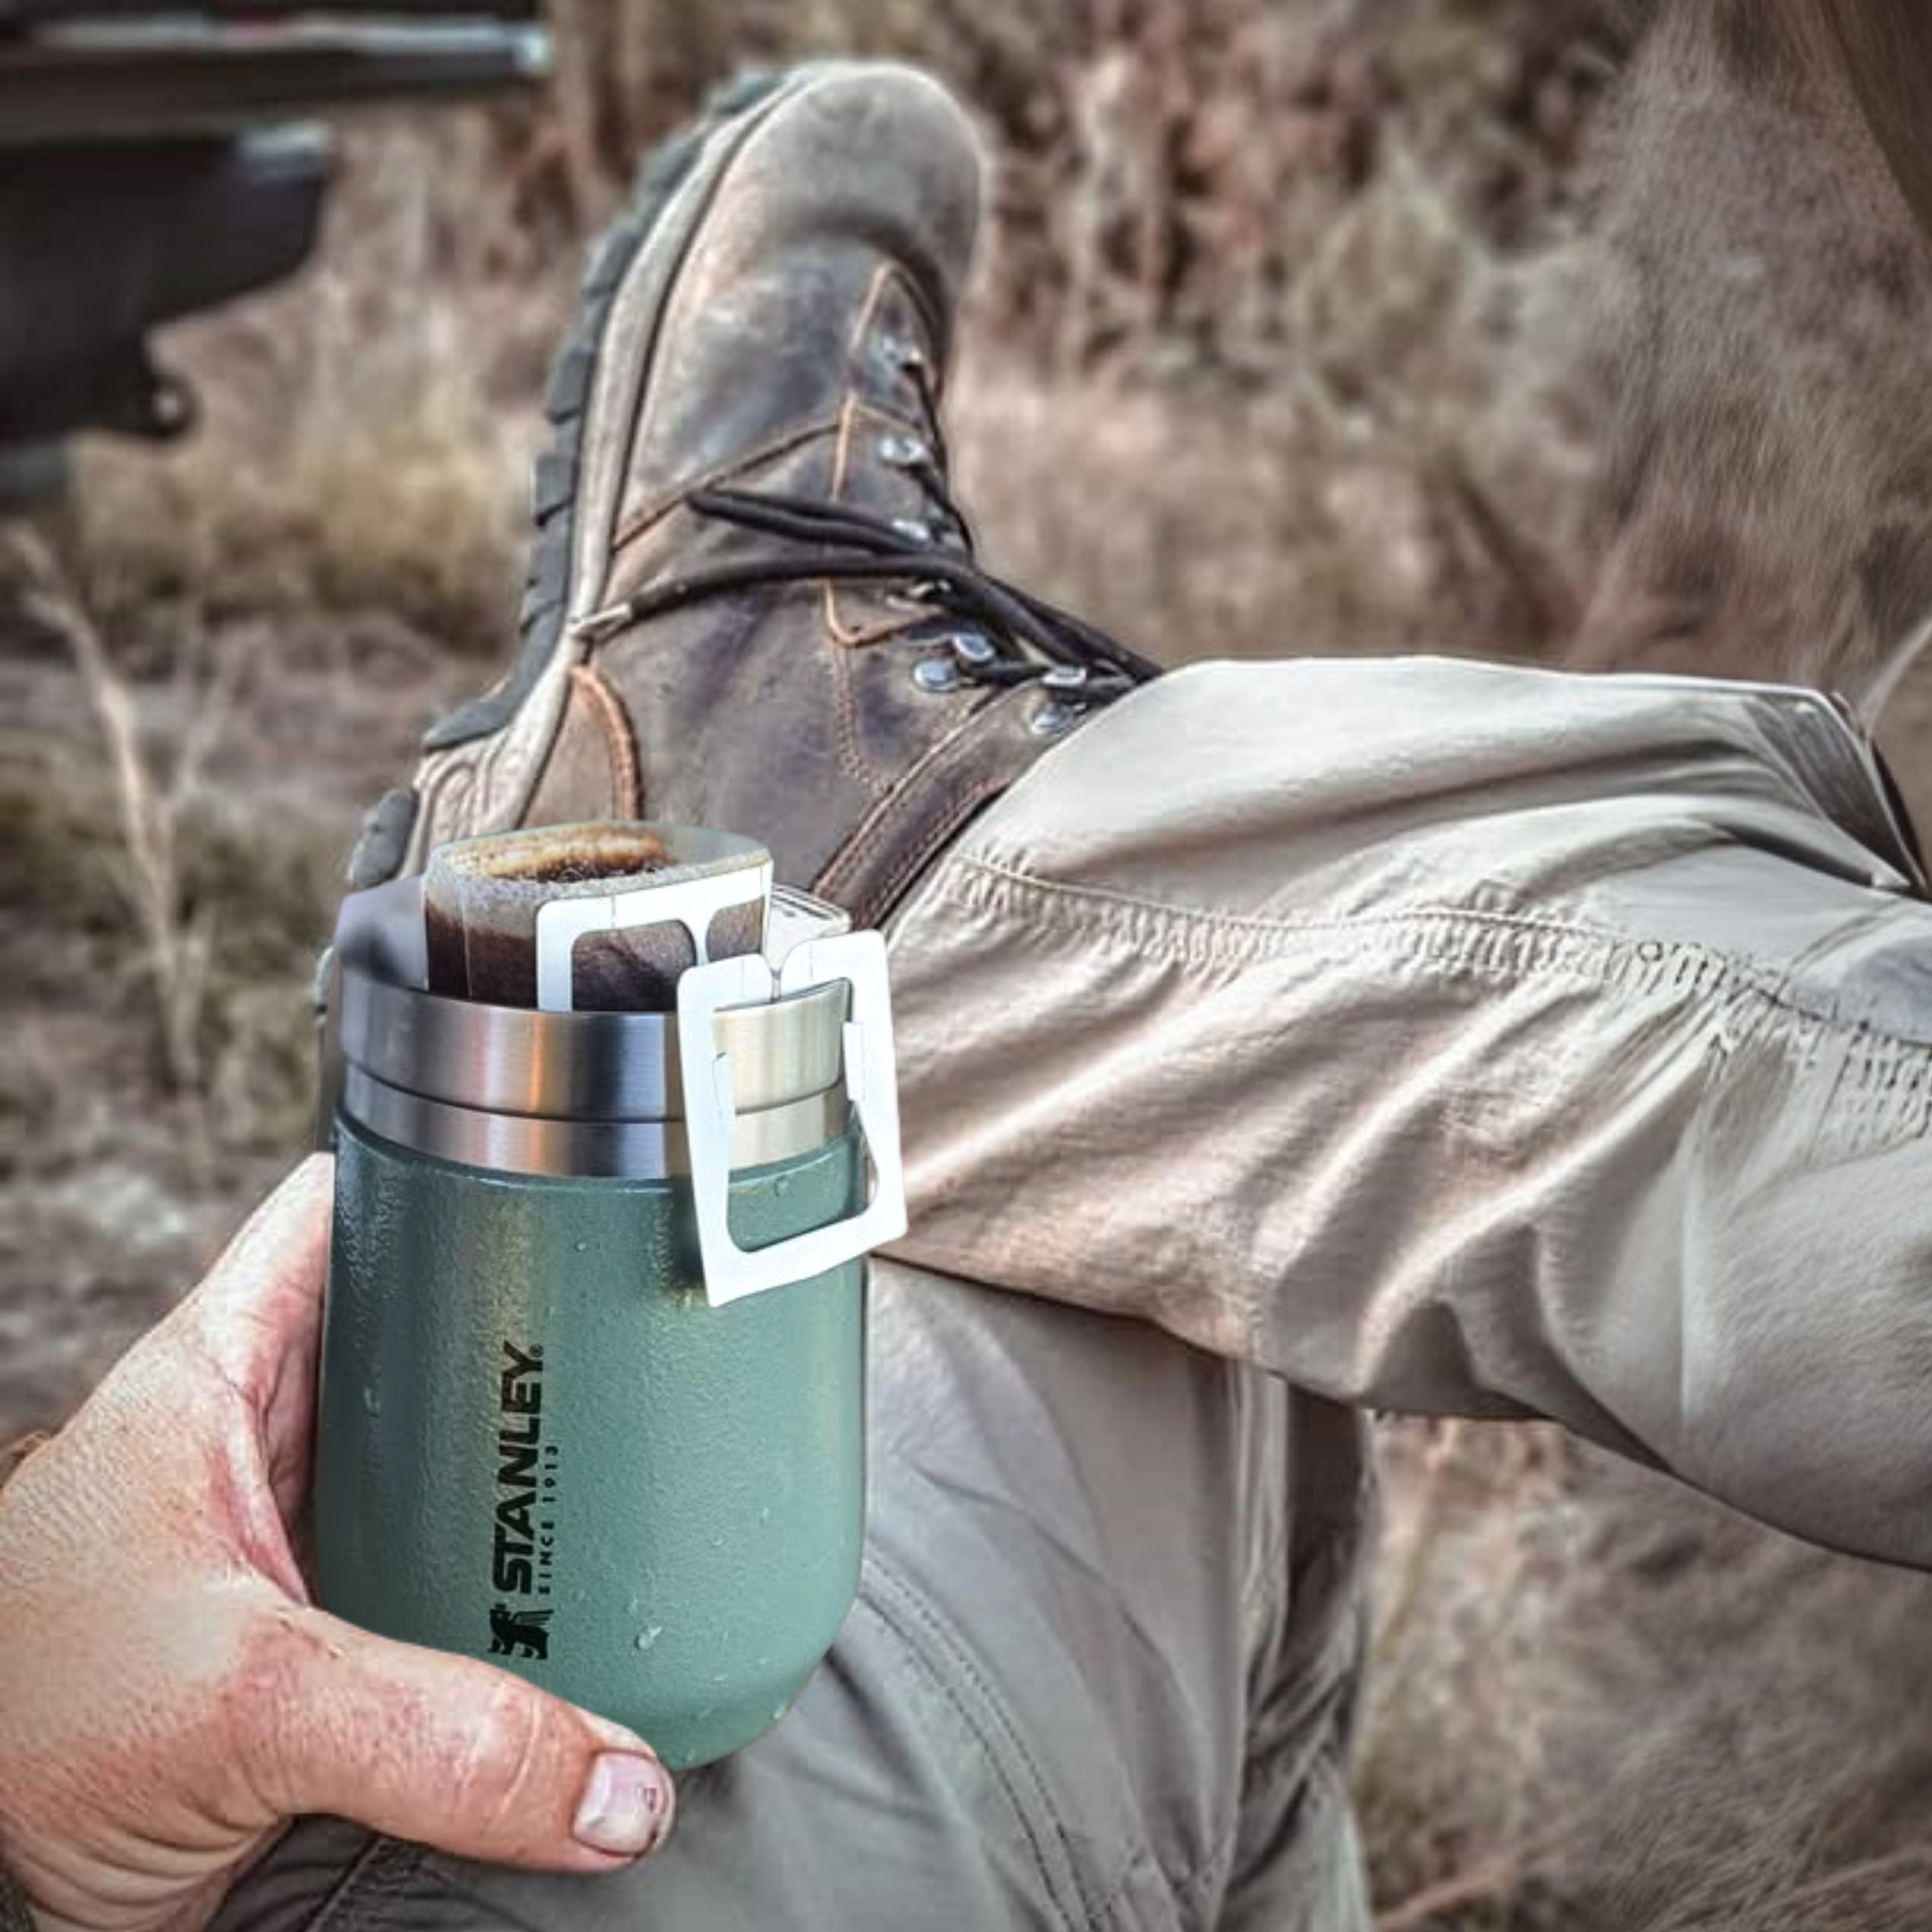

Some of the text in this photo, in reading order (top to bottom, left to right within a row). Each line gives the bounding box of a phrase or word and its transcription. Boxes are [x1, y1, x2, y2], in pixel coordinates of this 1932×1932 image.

[493, 1340, 543, 1594] STANLEY
[538, 1445, 558, 1594] SINCE 1913
